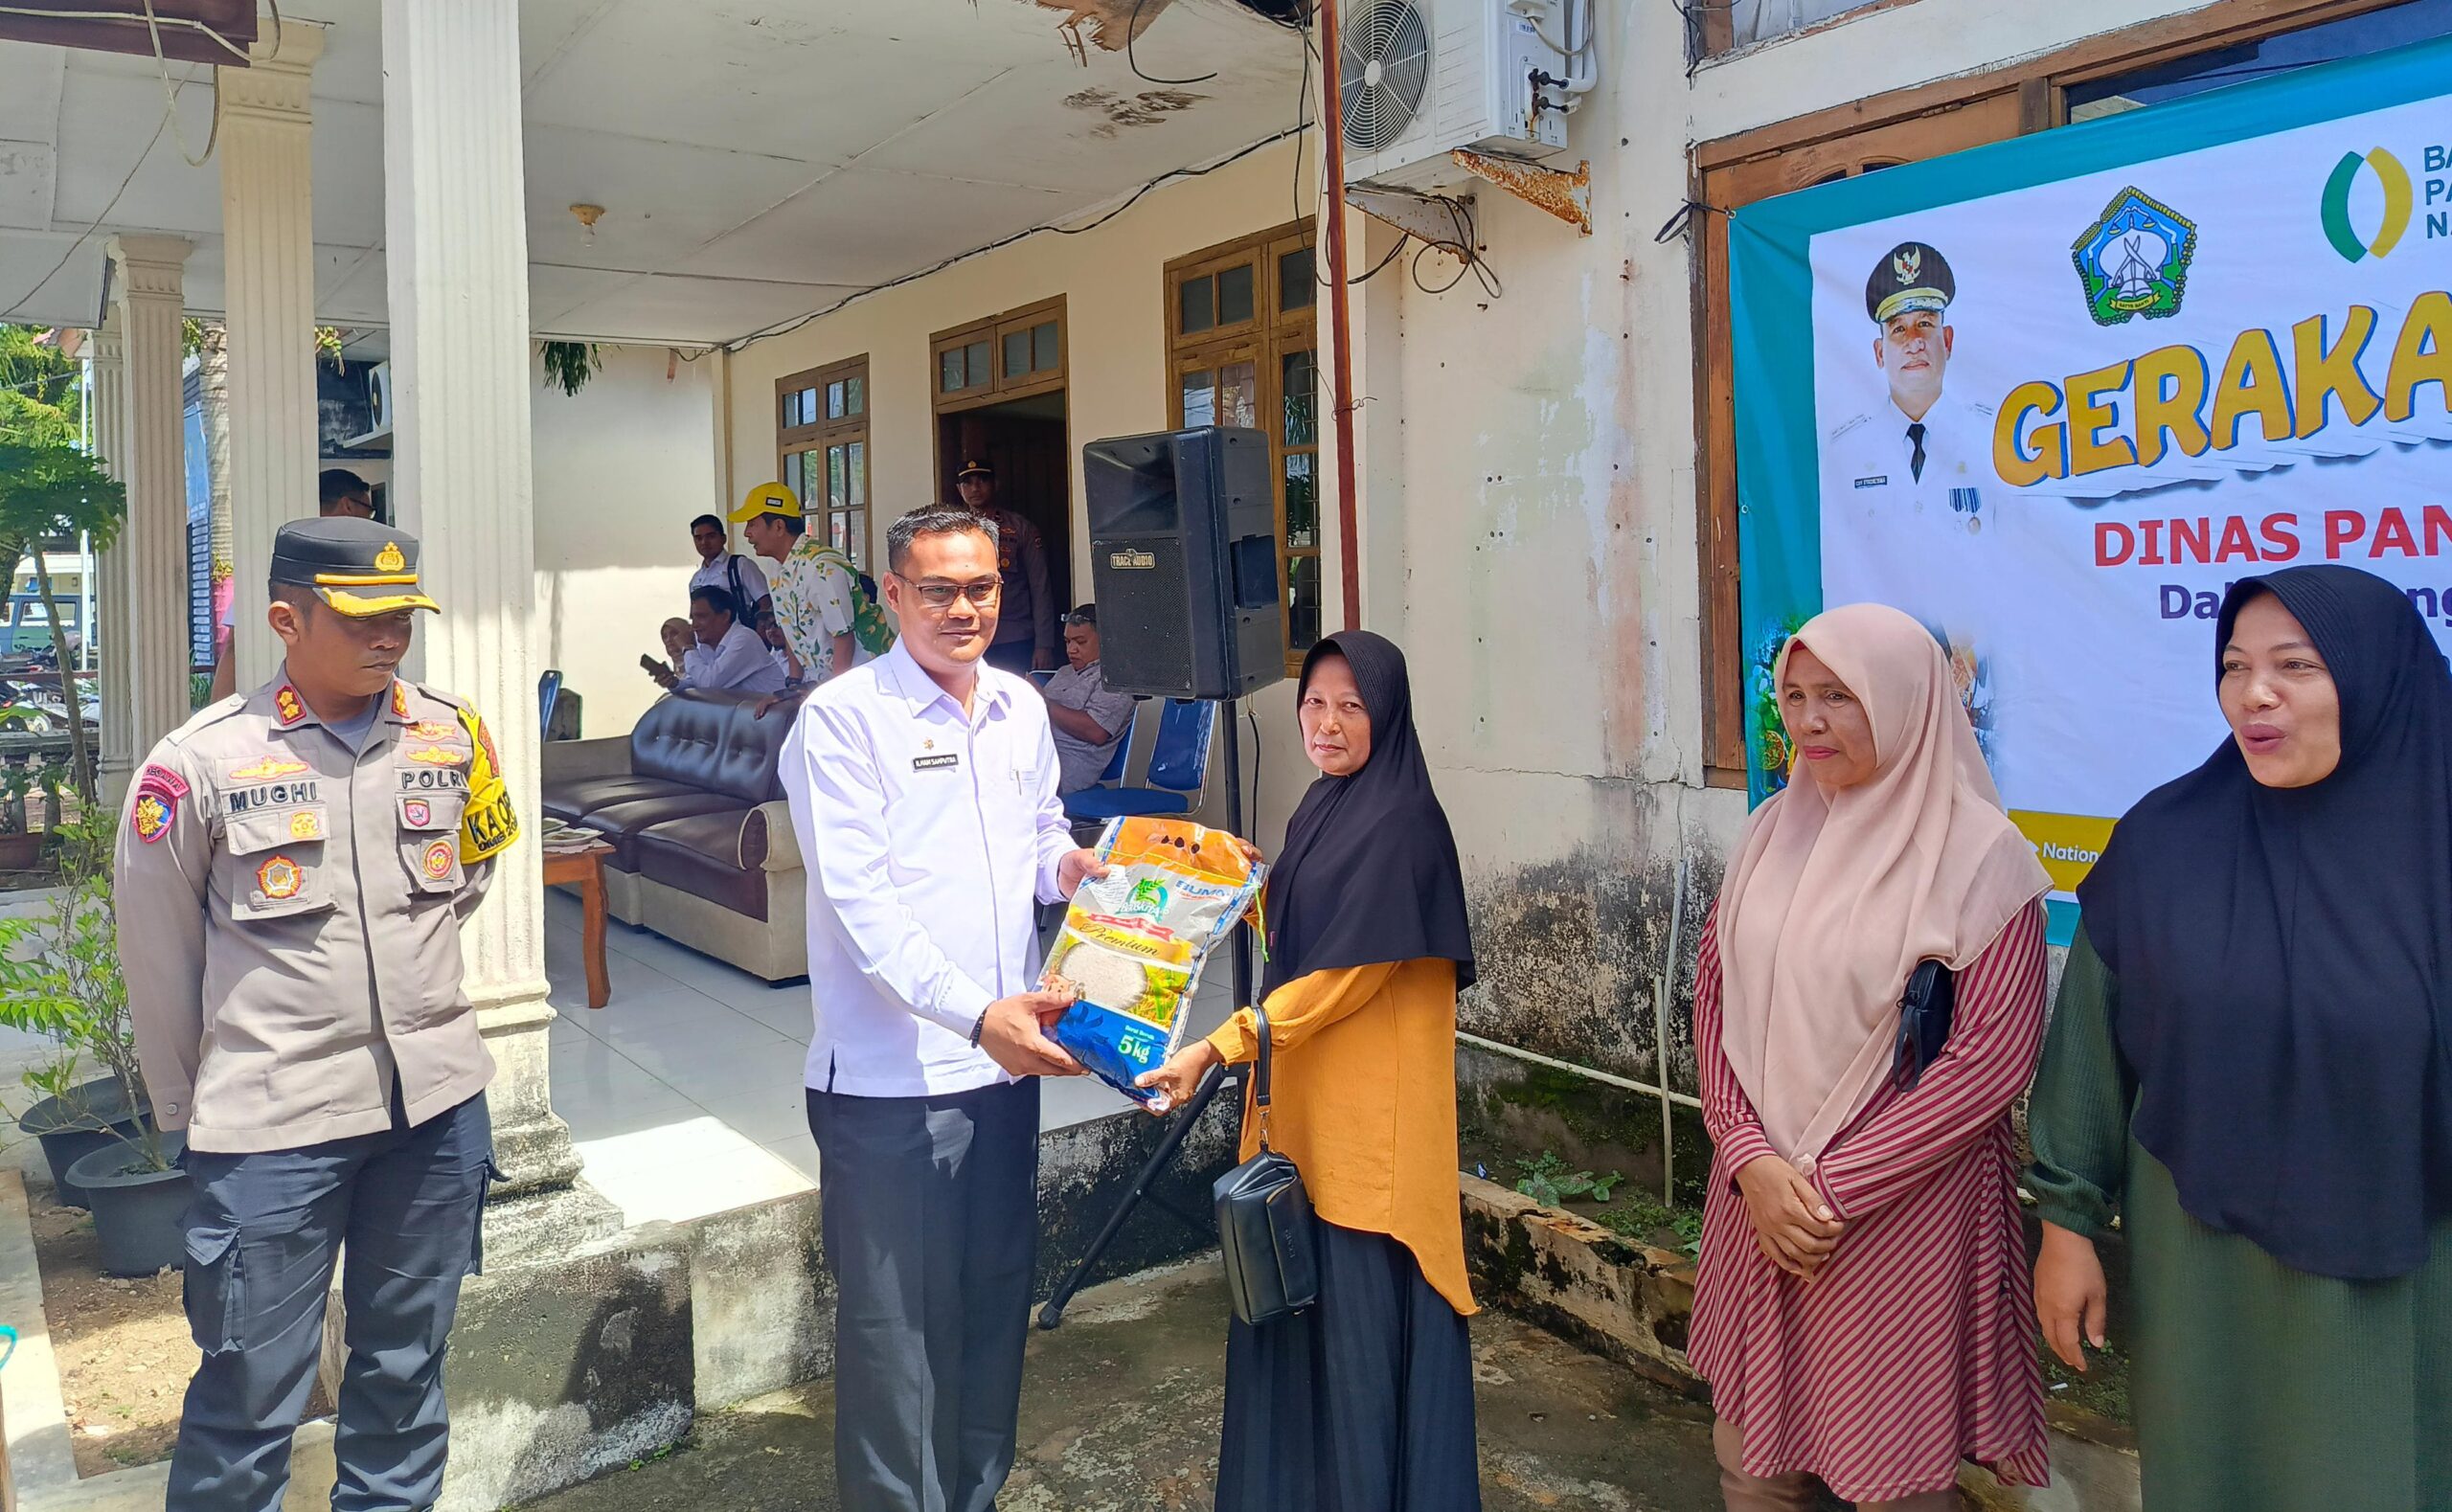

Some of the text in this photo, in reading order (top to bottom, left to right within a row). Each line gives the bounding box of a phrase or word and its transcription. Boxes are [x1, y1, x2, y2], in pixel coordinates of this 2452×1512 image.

[2095, 512, 2301, 567] DINAS
[230, 781, 317, 813] MUGHI
[1079, 923, 1159, 957] Premium
